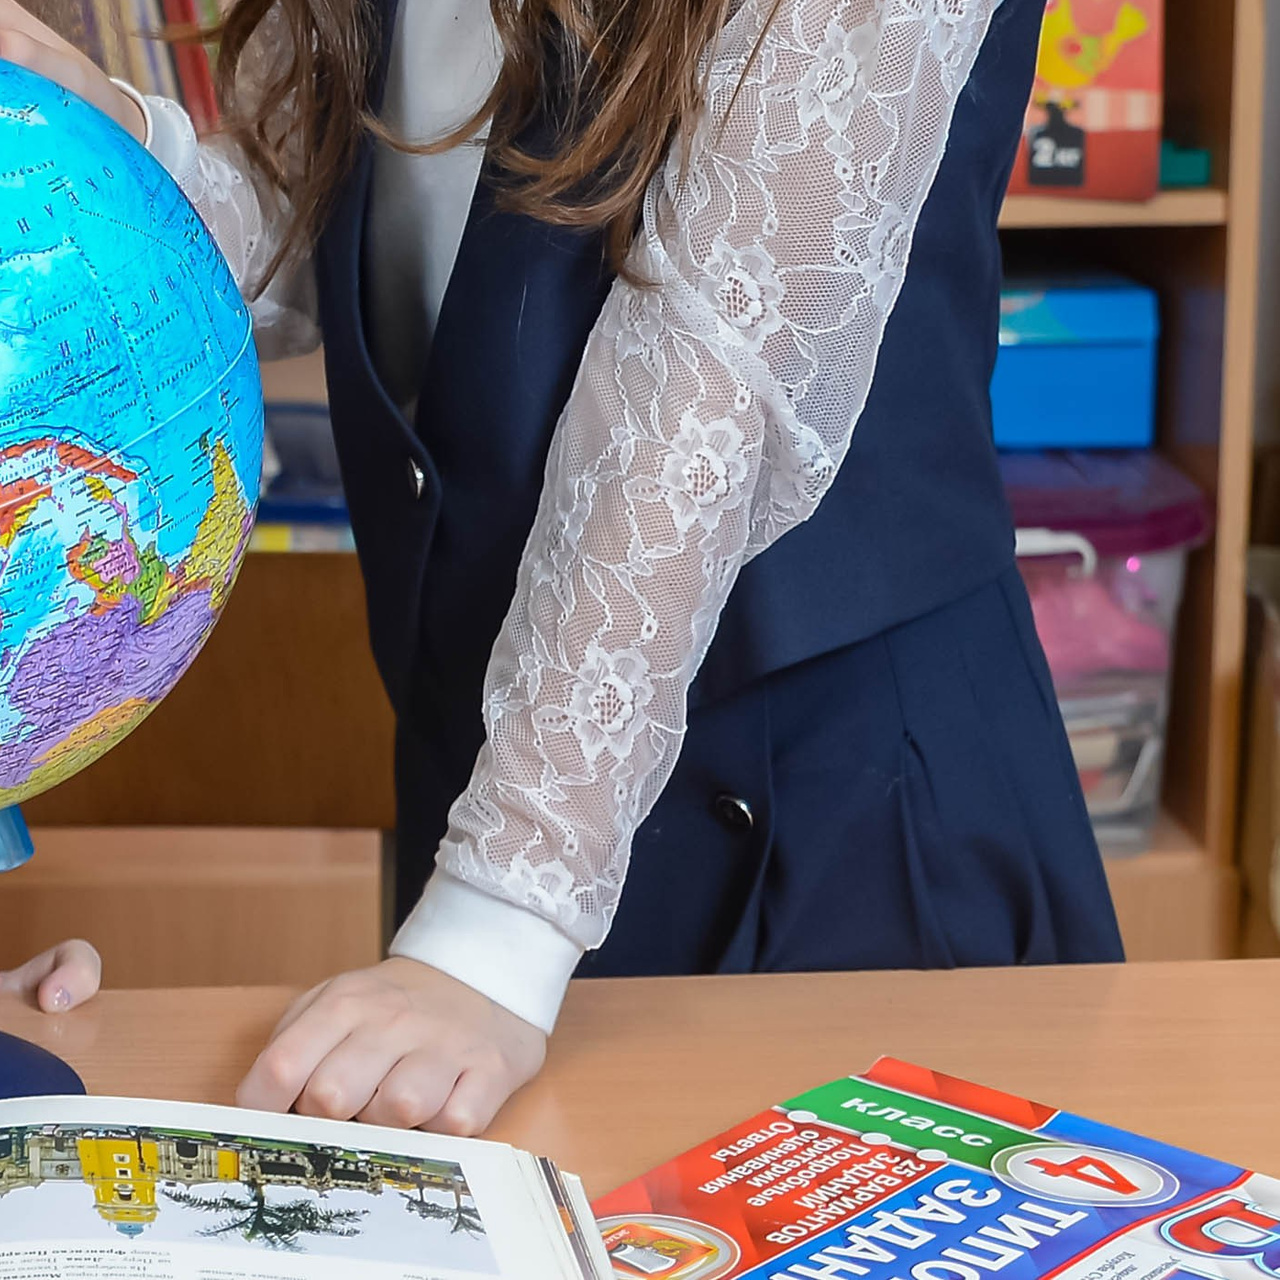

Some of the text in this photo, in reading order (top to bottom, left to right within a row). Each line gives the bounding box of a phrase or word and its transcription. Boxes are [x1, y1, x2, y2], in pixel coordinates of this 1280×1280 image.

[1032, 136, 1056, 168] 2
[709, 1120, 795, 1162] Ответы
[841, 1097, 992, 1147] класс
[697, 1129, 820, 1195] оценивания
[746, 1135, 843, 1189] критерии
[746, 1142, 870, 1209] Подробные
[792, 1152, 900, 1210] ЗАДАНИЙ
[1024, 1155, 1141, 1196] 4
[765, 1159, 926, 1245] 25 ВАРИАНТОВ
[768, 1178, 1002, 1280] ЗАДАН
[908, 1201, 1089, 1280] ТИПО
